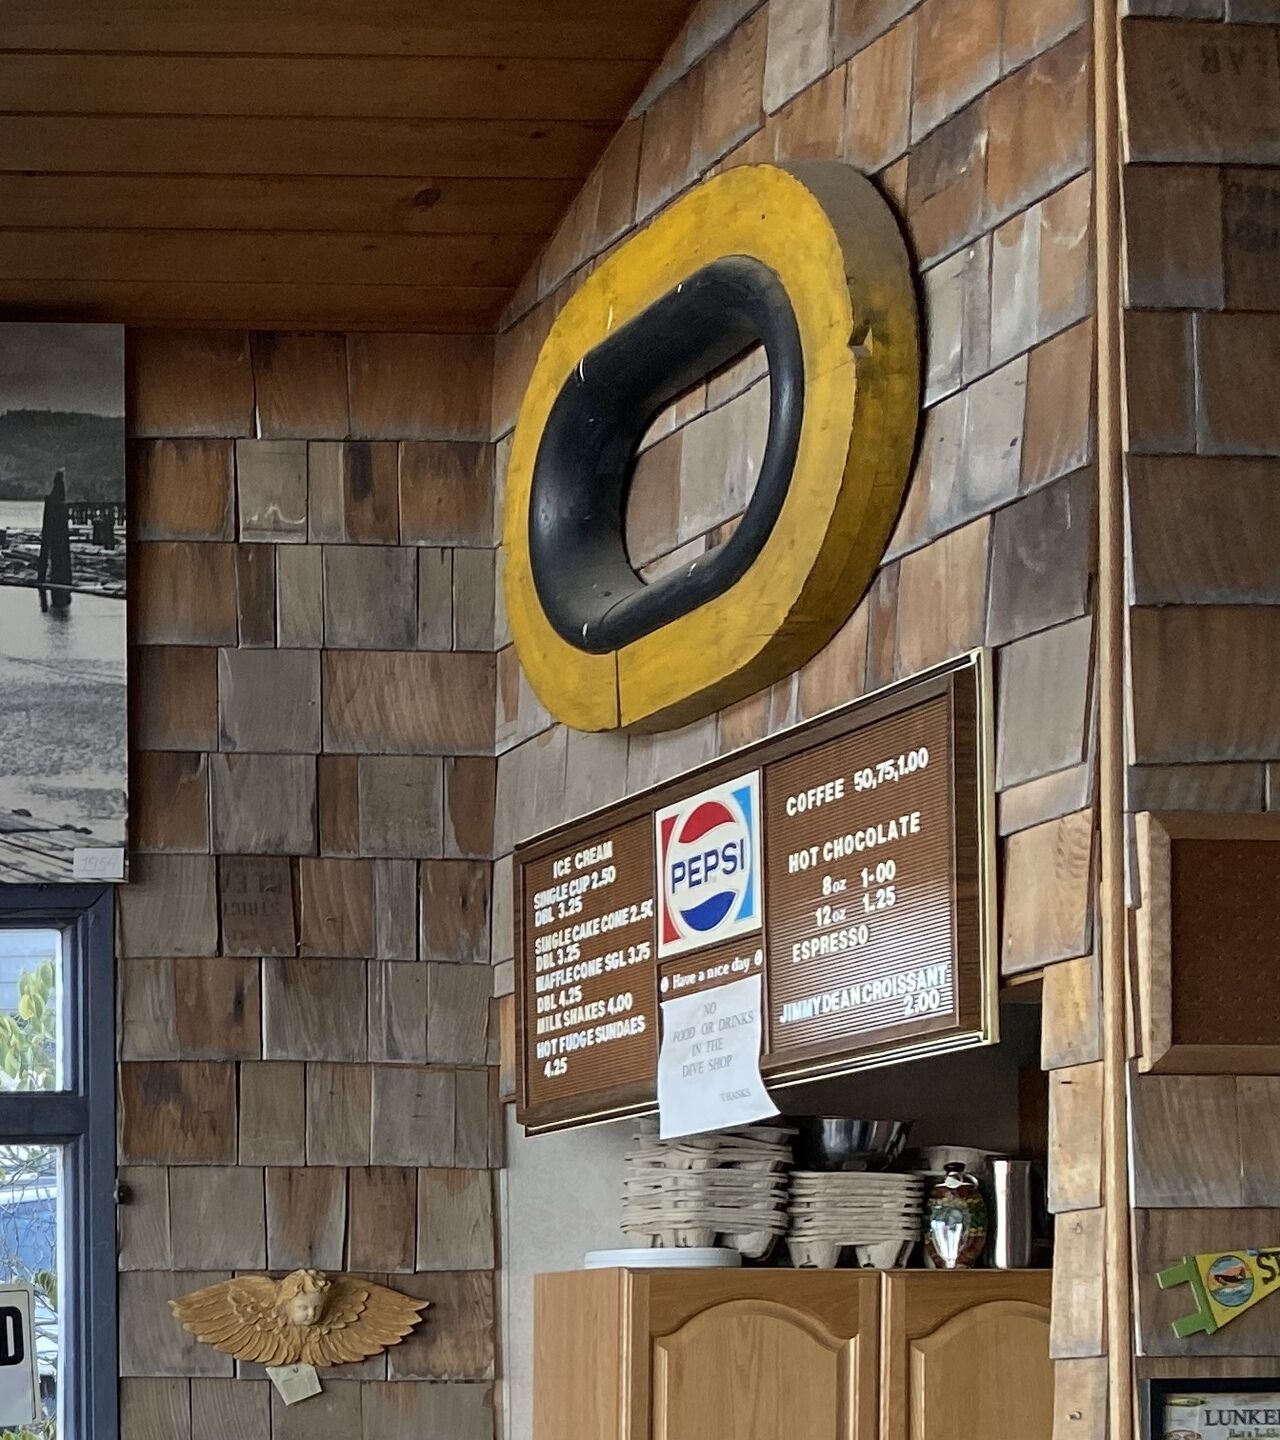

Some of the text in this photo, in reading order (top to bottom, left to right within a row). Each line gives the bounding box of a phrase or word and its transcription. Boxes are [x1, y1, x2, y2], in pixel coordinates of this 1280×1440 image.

[786, 777, 845, 817] COFFEE
[553, 841, 613, 879] ICE CREAM
[788, 811, 921, 874] HOT CHOCOLATE
[671, 838, 744, 894] PEPSI
[533, 865, 616, 910] SINGLE CUP 2.50
[862, 885, 896, 913] 1.25
[535, 896, 583, 927] DBL 3.25
[535, 928, 572, 955] SINGLE
[572, 918, 600, 942] CAKE
[601, 907, 629, 932] CONE
[792, 924, 869, 963] ESPRESSO
[535, 943, 580, 972] DBL 3.25
[536, 941, 650, 993] WAFFLE CONE SGL 3.75
[672, 956, 750, 990] Have a nice day
[537, 985, 583, 1014] DBL 4.25
[704, 1001, 717, 1016] NO
[779, 963, 948, 1023] JIMMY DEAN CROISSANT
[537, 992, 633, 1034] MILK SHAKES 4.00
[673, 1010, 754, 1042] FOOD OR DRINKS
[537, 1015, 646, 1059] HOT FUDGE SUNDAES
[691, 1037, 724, 1057] IN THE
[544, 1057, 567, 1078] 4.25
[682, 1055, 733, 1077] DIVE SHOP
